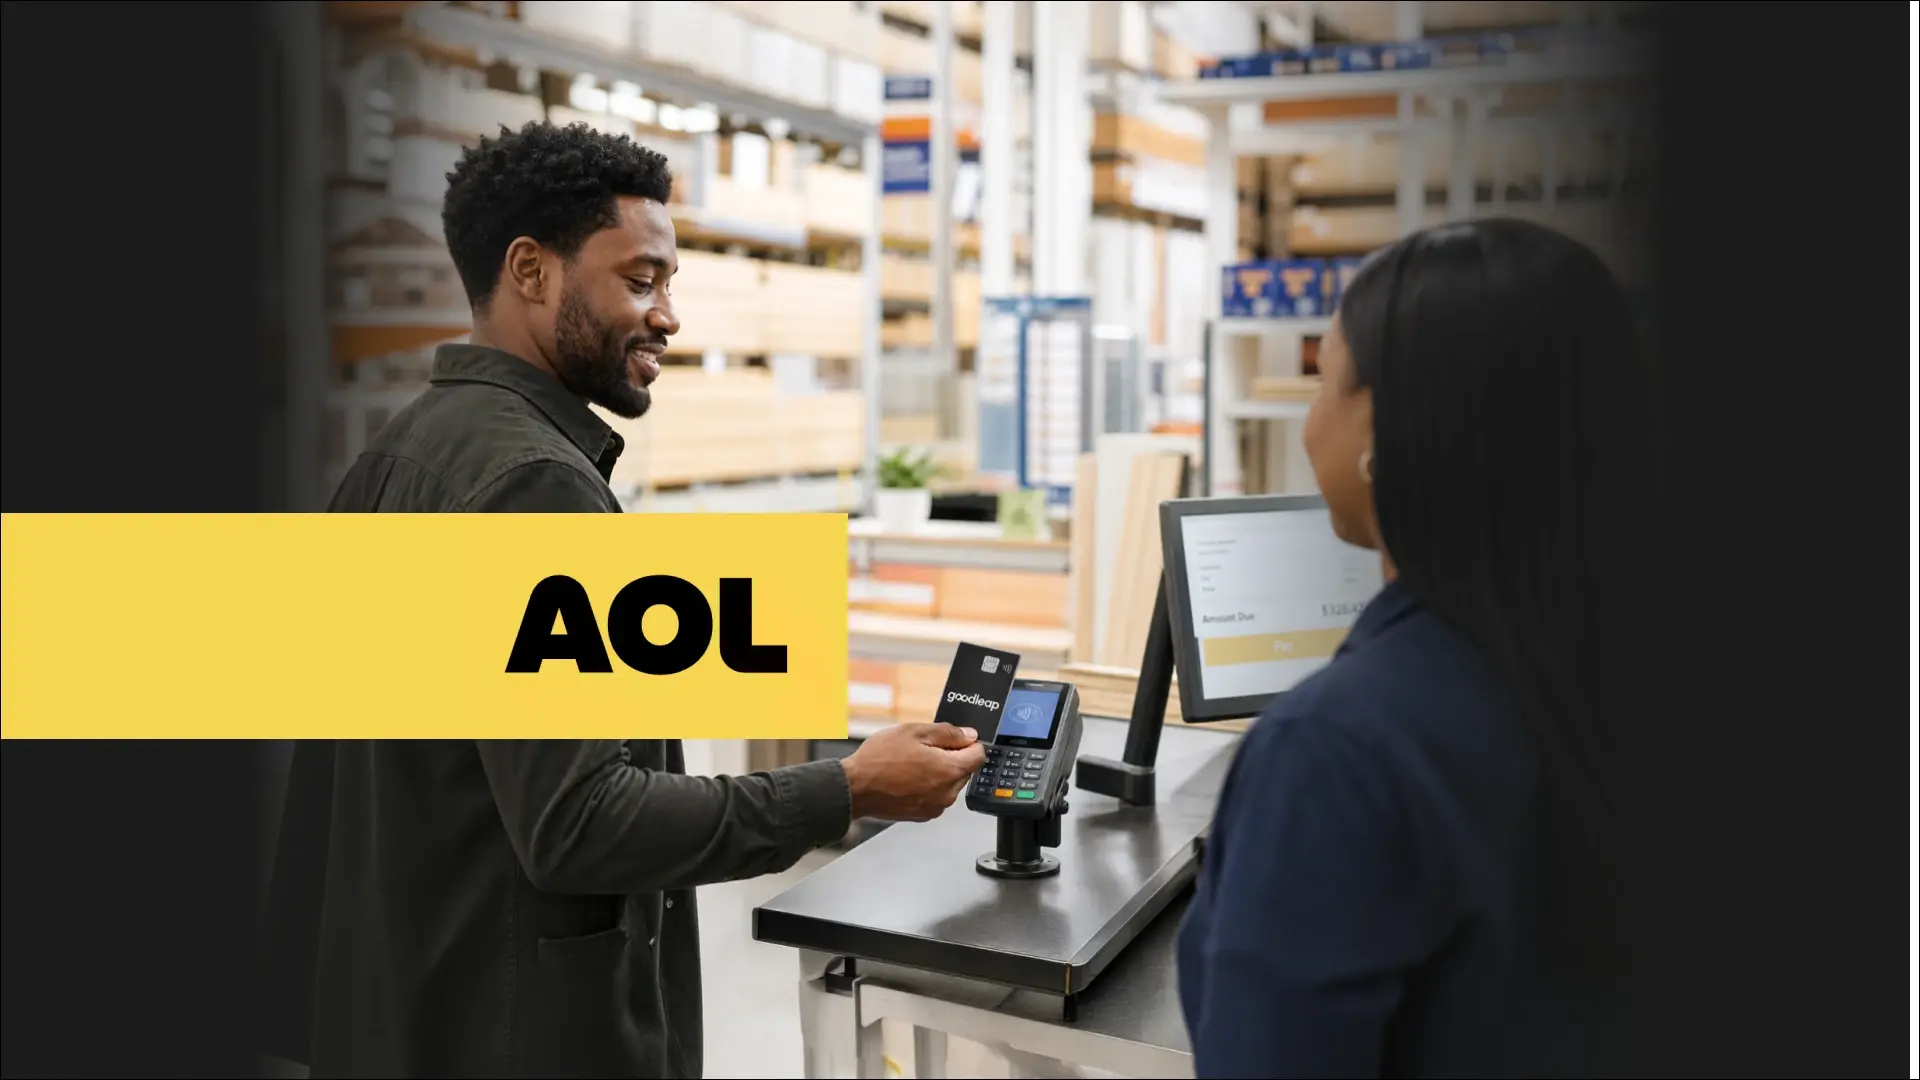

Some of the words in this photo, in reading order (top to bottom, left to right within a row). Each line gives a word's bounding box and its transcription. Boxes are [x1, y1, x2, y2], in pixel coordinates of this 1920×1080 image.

[1202, 614, 1236, 624] Amount
[1238, 611, 1255, 622] Due
[946, 691, 1000, 712] goodleap
